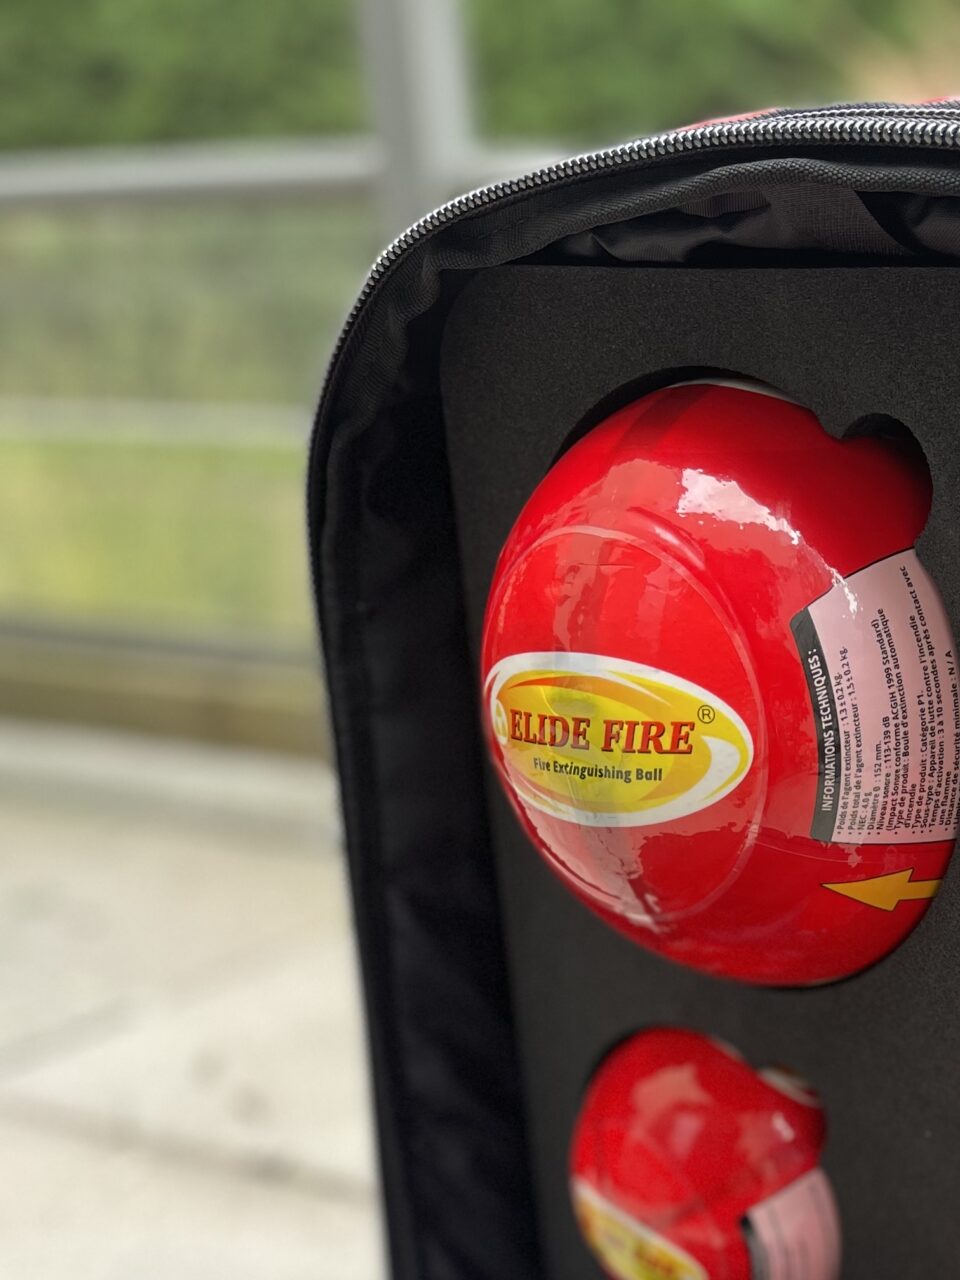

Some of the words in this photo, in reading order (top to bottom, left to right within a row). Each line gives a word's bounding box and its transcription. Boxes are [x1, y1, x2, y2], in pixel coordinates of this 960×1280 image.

[899, 565, 914, 588] avec
[908, 589, 927, 627] contact
[870, 619, 890, 666] Standard)
[876, 608, 900, 670] automatique
[908, 614, 927, 664] l'incendie
[921, 628, 935, 657] après
[945, 650, 952, 658] A
[842, 662, 851, 676] 0.2
[884, 667, 895, 689] 1999
[921, 665, 933, 698] contre
[930, 659, 942, 705] secondes
[948, 667, 955, 676] N
[808, 655, 832, 729] TECHNIQUES
[835, 688, 845, 701] 0.2
[846, 682, 856, 696] 1.5
[894, 671, 909, 728] d'extinction
[840, 708, 848, 721] 1.3
[888, 691, 899, 720] ACGIH
[927, 699, 935, 724] lutte
[936, 706, 943, 718] 10
[951, 683, 960, 729] minimale
[509, 708, 591, 750] ELIDE
[600, 720, 696, 755] FIRE
[851, 703, 862, 748] extincteur
[882, 716, 890, 728] dB
[918, 707, 929, 753] Catégorie
[928, 725, 936, 738] de
[843, 730, 852, 771] extincteur
[883, 730, 892, 763] 113-139
[892, 722, 901, 767] conforme
[901, 730, 910, 757] Boule
[532, 757, 551, 772] Fire
[552, 760, 632, 783] Extinguishing
[635, 768, 663, 782] Ball
[821, 731, 836, 811] INFORMATIONS
[854, 750, 864, 778] l'agent
[928, 740, 937, 778] Appareil
[934, 741, 944, 797] d'activation
[842, 773, 852, 800] l'agent
[854, 780, 862, 790] de
[883, 772, 891, 799] sonore
[891, 769, 900, 796] Sonore
[901, 763, 909, 794] produit
[918, 759, 927, 794] produit
[940, 770, 952, 807] flamme
[951, 773, 959, 785] de
[841, 801, 849, 810] de
[867, 793, 879, 830] Diamètre
[874, 763, 882, 778] 152
[897, 796, 906, 808] de
[903, 783, 917, 828] d'incendie
[916, 795, 923, 807] de
[920, 785, 934, 829] Sous-type
[944, 787, 957, 826] Distance
[837, 811, 848, 830] Poids
[848, 810, 858, 830] Poids
[857, 815, 867, 830] NEC
[862, 798, 870, 809] 4.0
[876, 801, 888, 830] Niveau
[885, 798, 898, 831] (Impact
[893, 810, 904, 829] Type
[911, 808, 922, 829] Type
[928, 798, 940, 828] Temps
[938, 808, 946, 826] une
